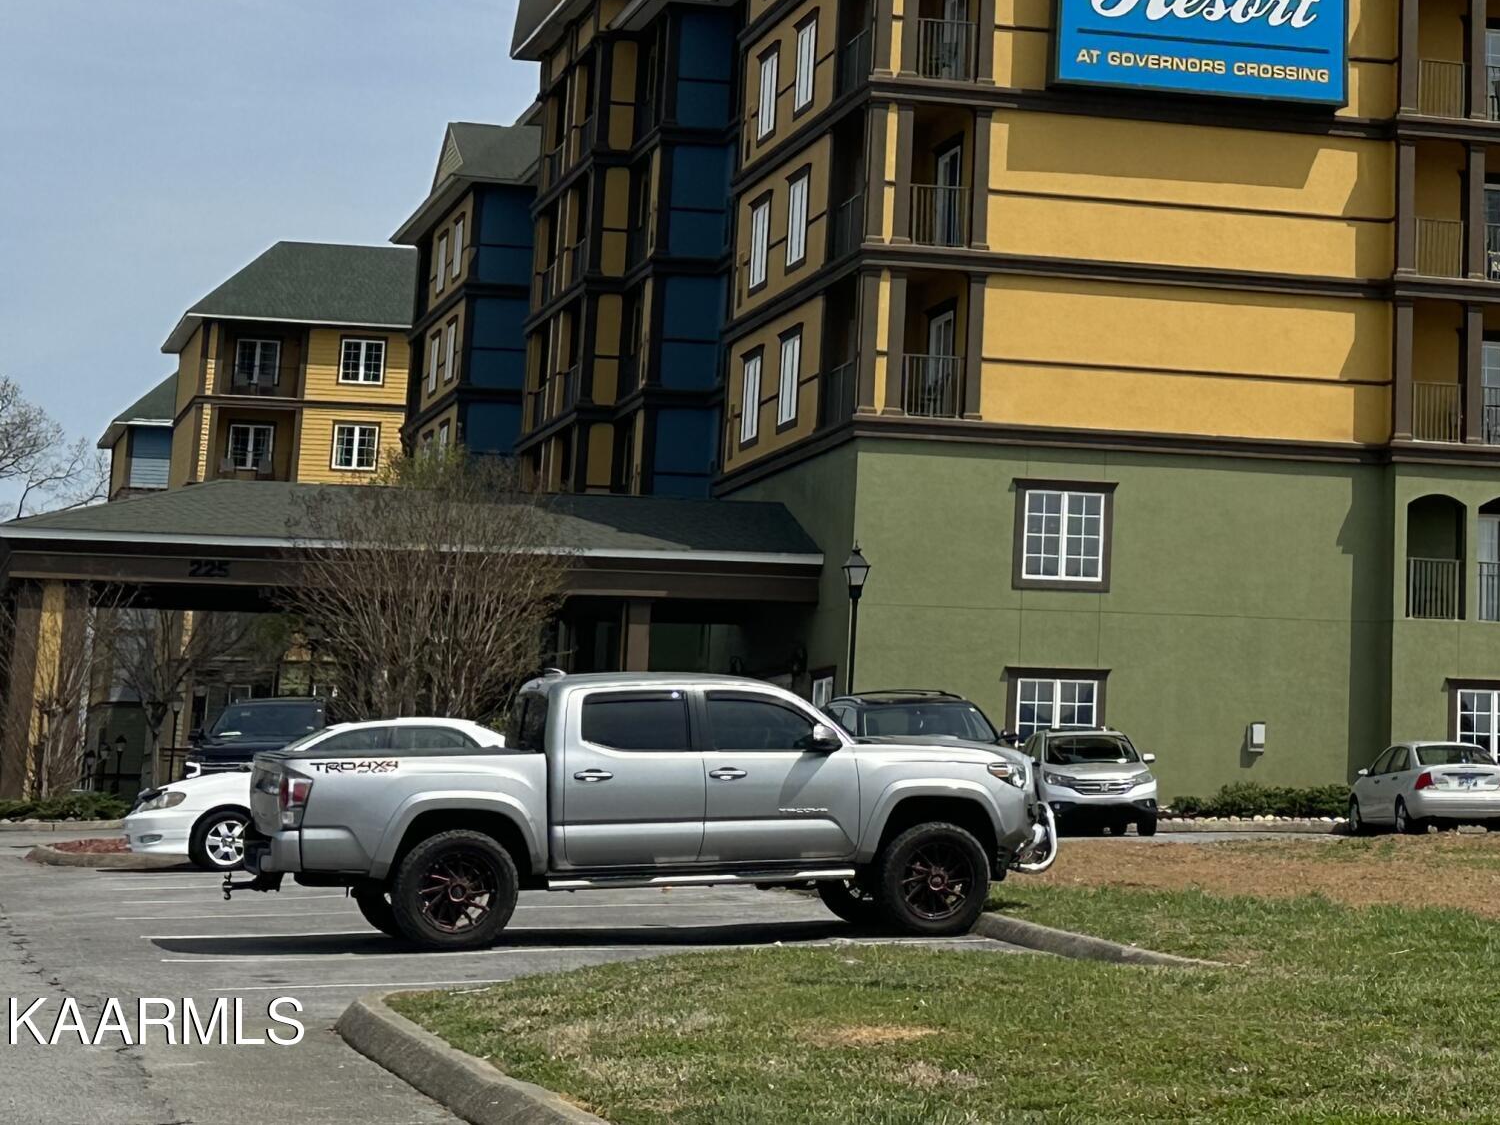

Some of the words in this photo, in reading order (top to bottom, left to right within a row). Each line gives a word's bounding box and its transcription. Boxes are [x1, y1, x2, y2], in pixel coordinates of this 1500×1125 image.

[1076, 48, 1101, 64] AT
[1107, 51, 1226, 74] GOVERNORS
[1233, 64, 1329, 83] CROSSING
[189, 560, 230, 577] 225
